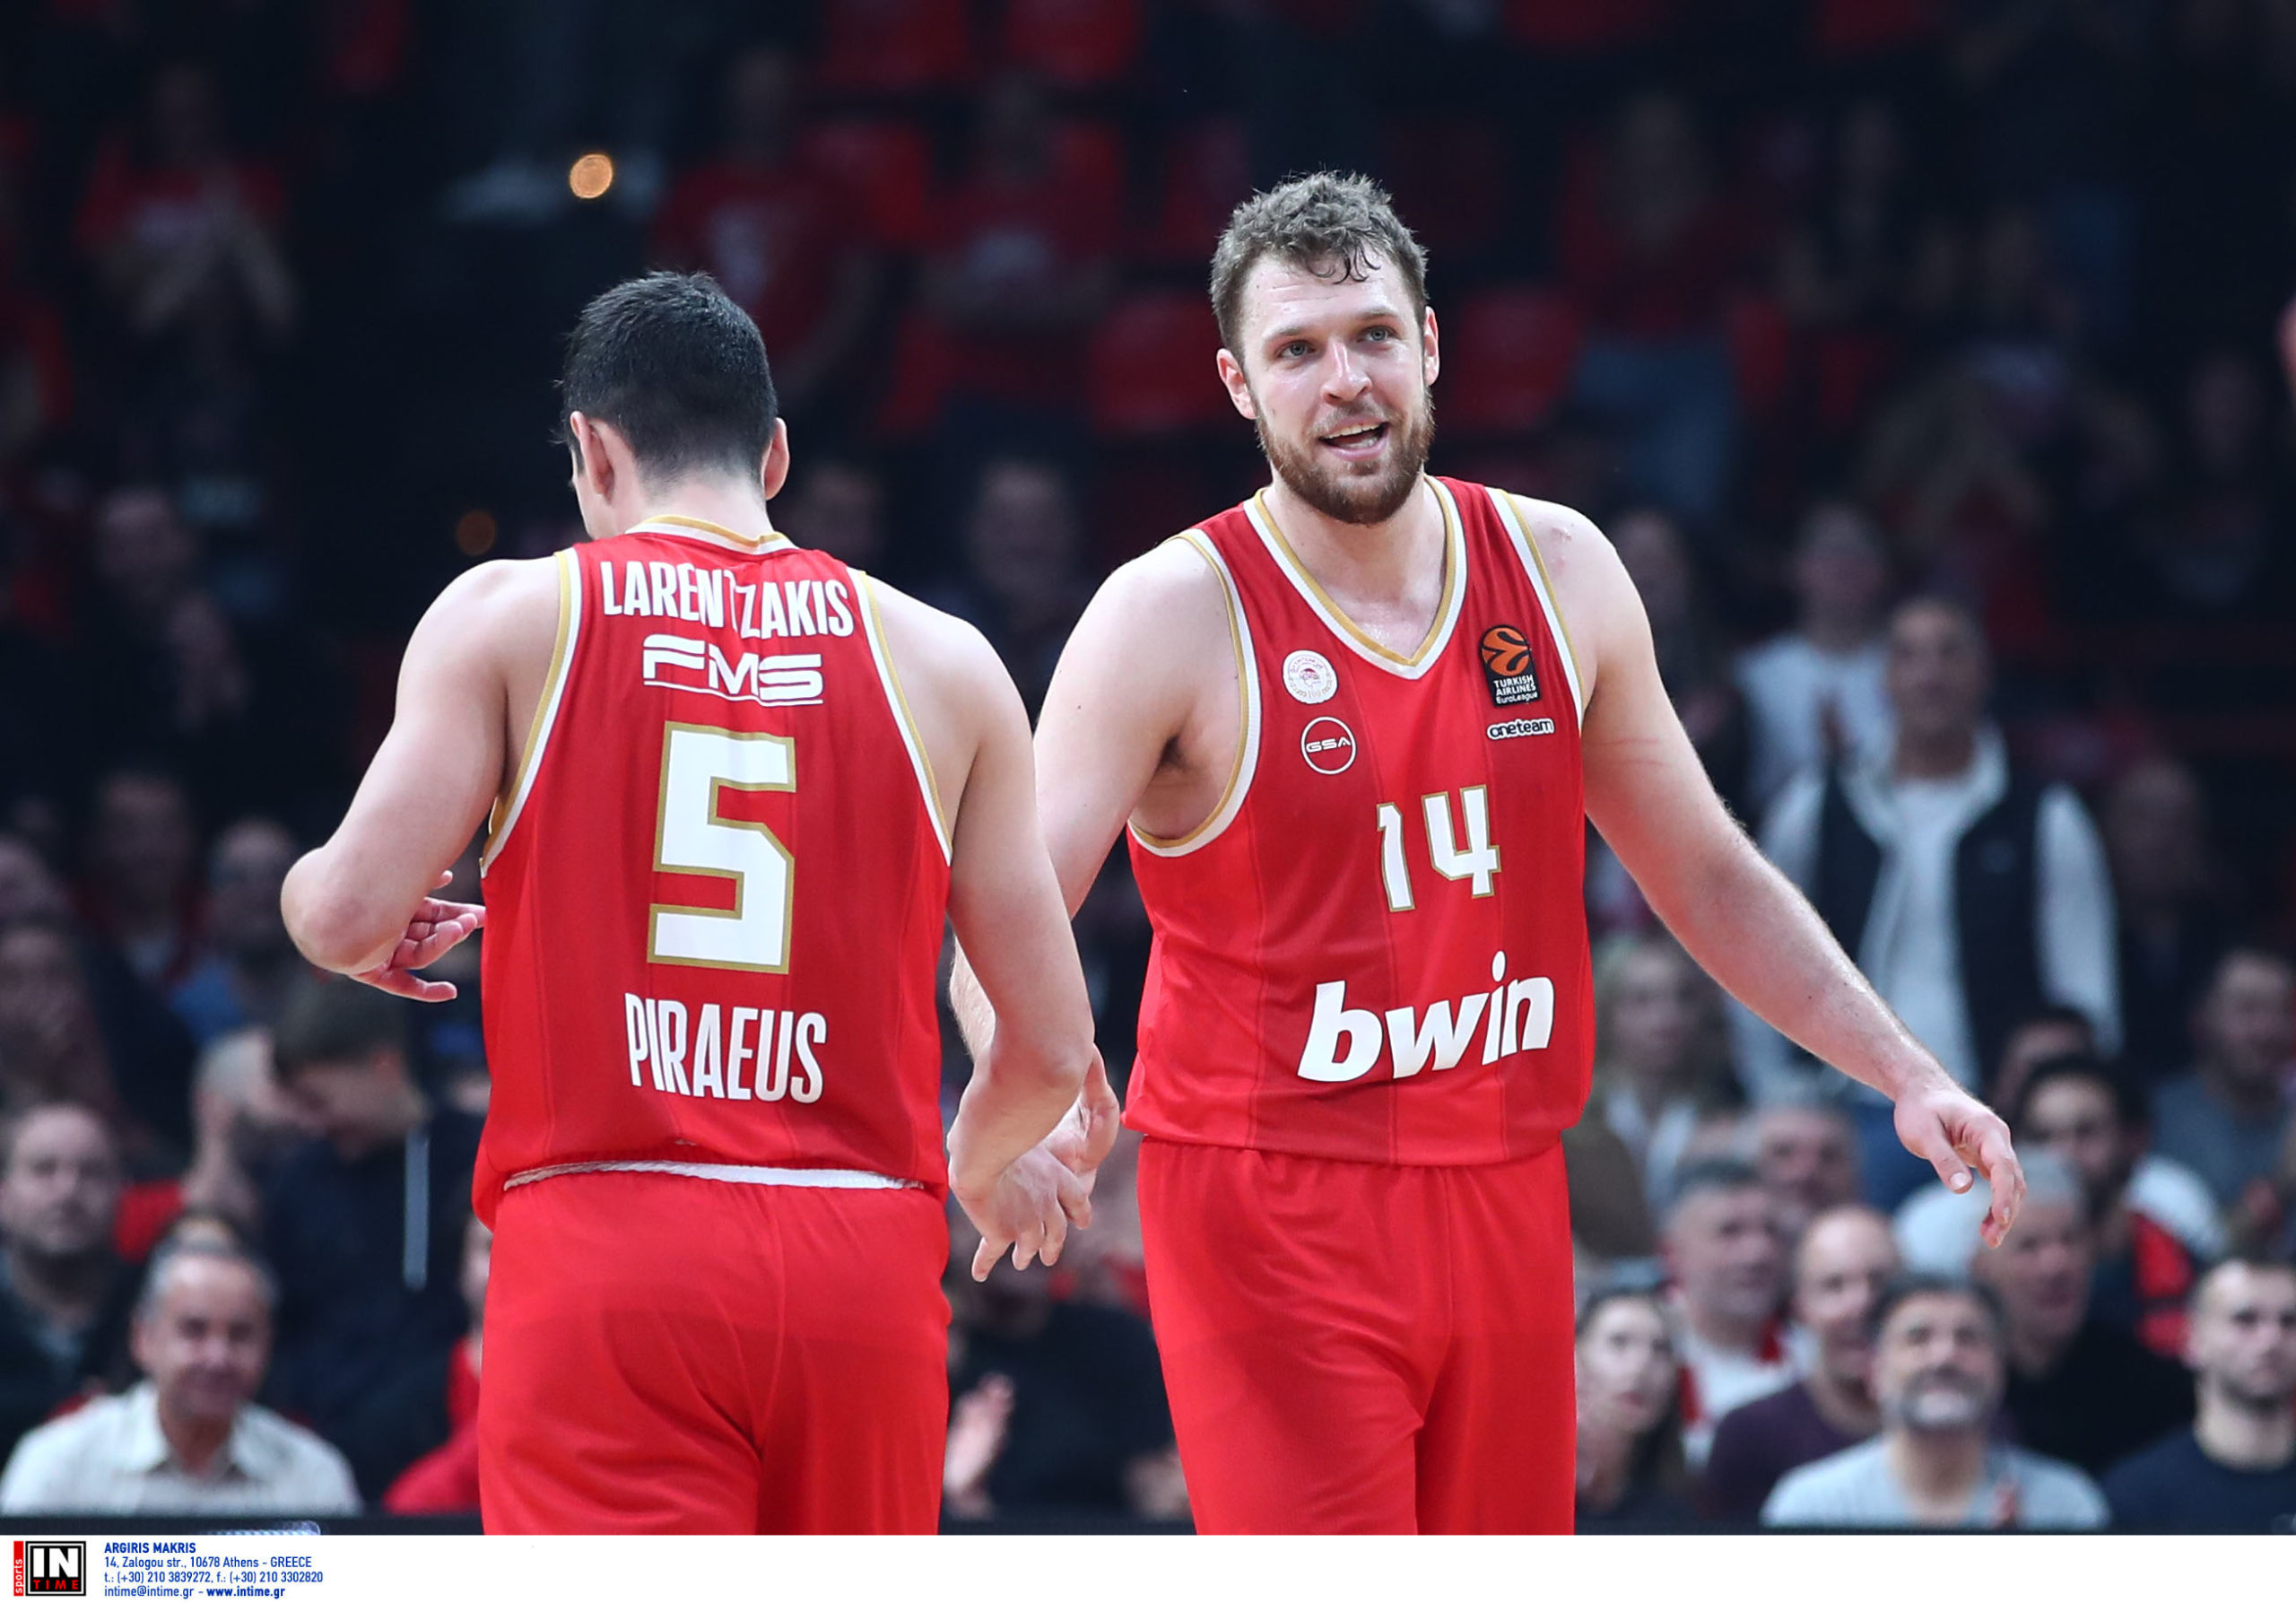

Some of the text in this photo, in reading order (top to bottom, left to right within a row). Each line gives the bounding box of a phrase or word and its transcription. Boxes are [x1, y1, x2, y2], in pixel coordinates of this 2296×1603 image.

[643, 634, 823, 708] FMS
[1493, 675, 1535, 688] TURKISH
[1496, 683, 1536, 696] AIRLINES
[1306, 736, 1351, 753] GSA
[648, 720, 796, 974] 5
[1376, 784, 1501, 912] 14
[625, 992, 827, 1103] PIRAEUS
[1297, 950, 1554, 1082] bwin
